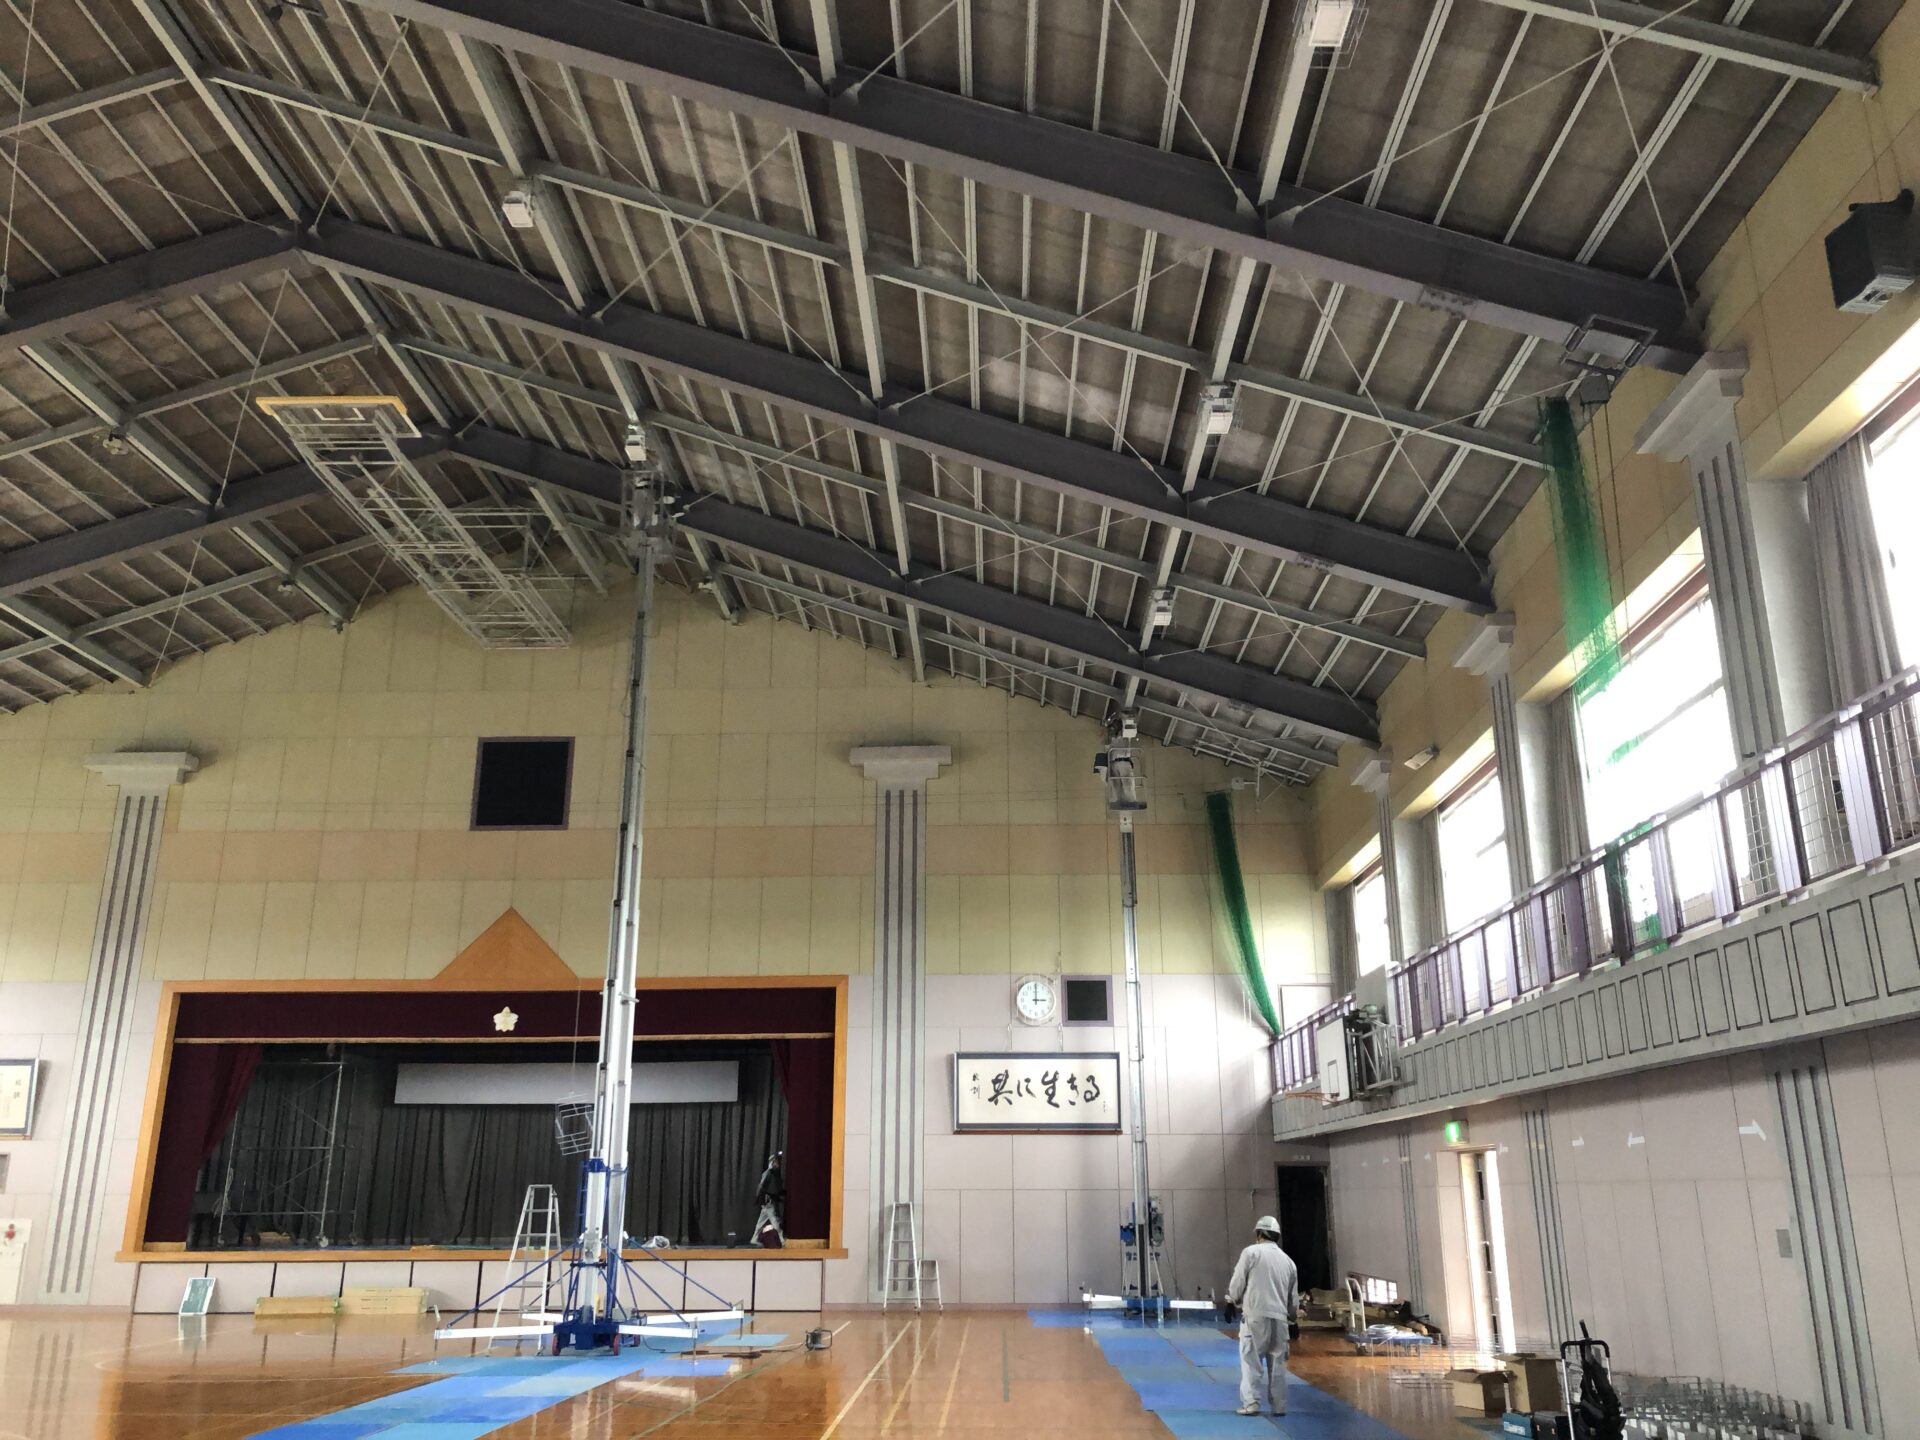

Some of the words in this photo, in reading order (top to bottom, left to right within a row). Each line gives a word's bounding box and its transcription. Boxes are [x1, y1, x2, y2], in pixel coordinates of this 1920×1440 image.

[987, 1069, 1101, 1109] 共に生きる
